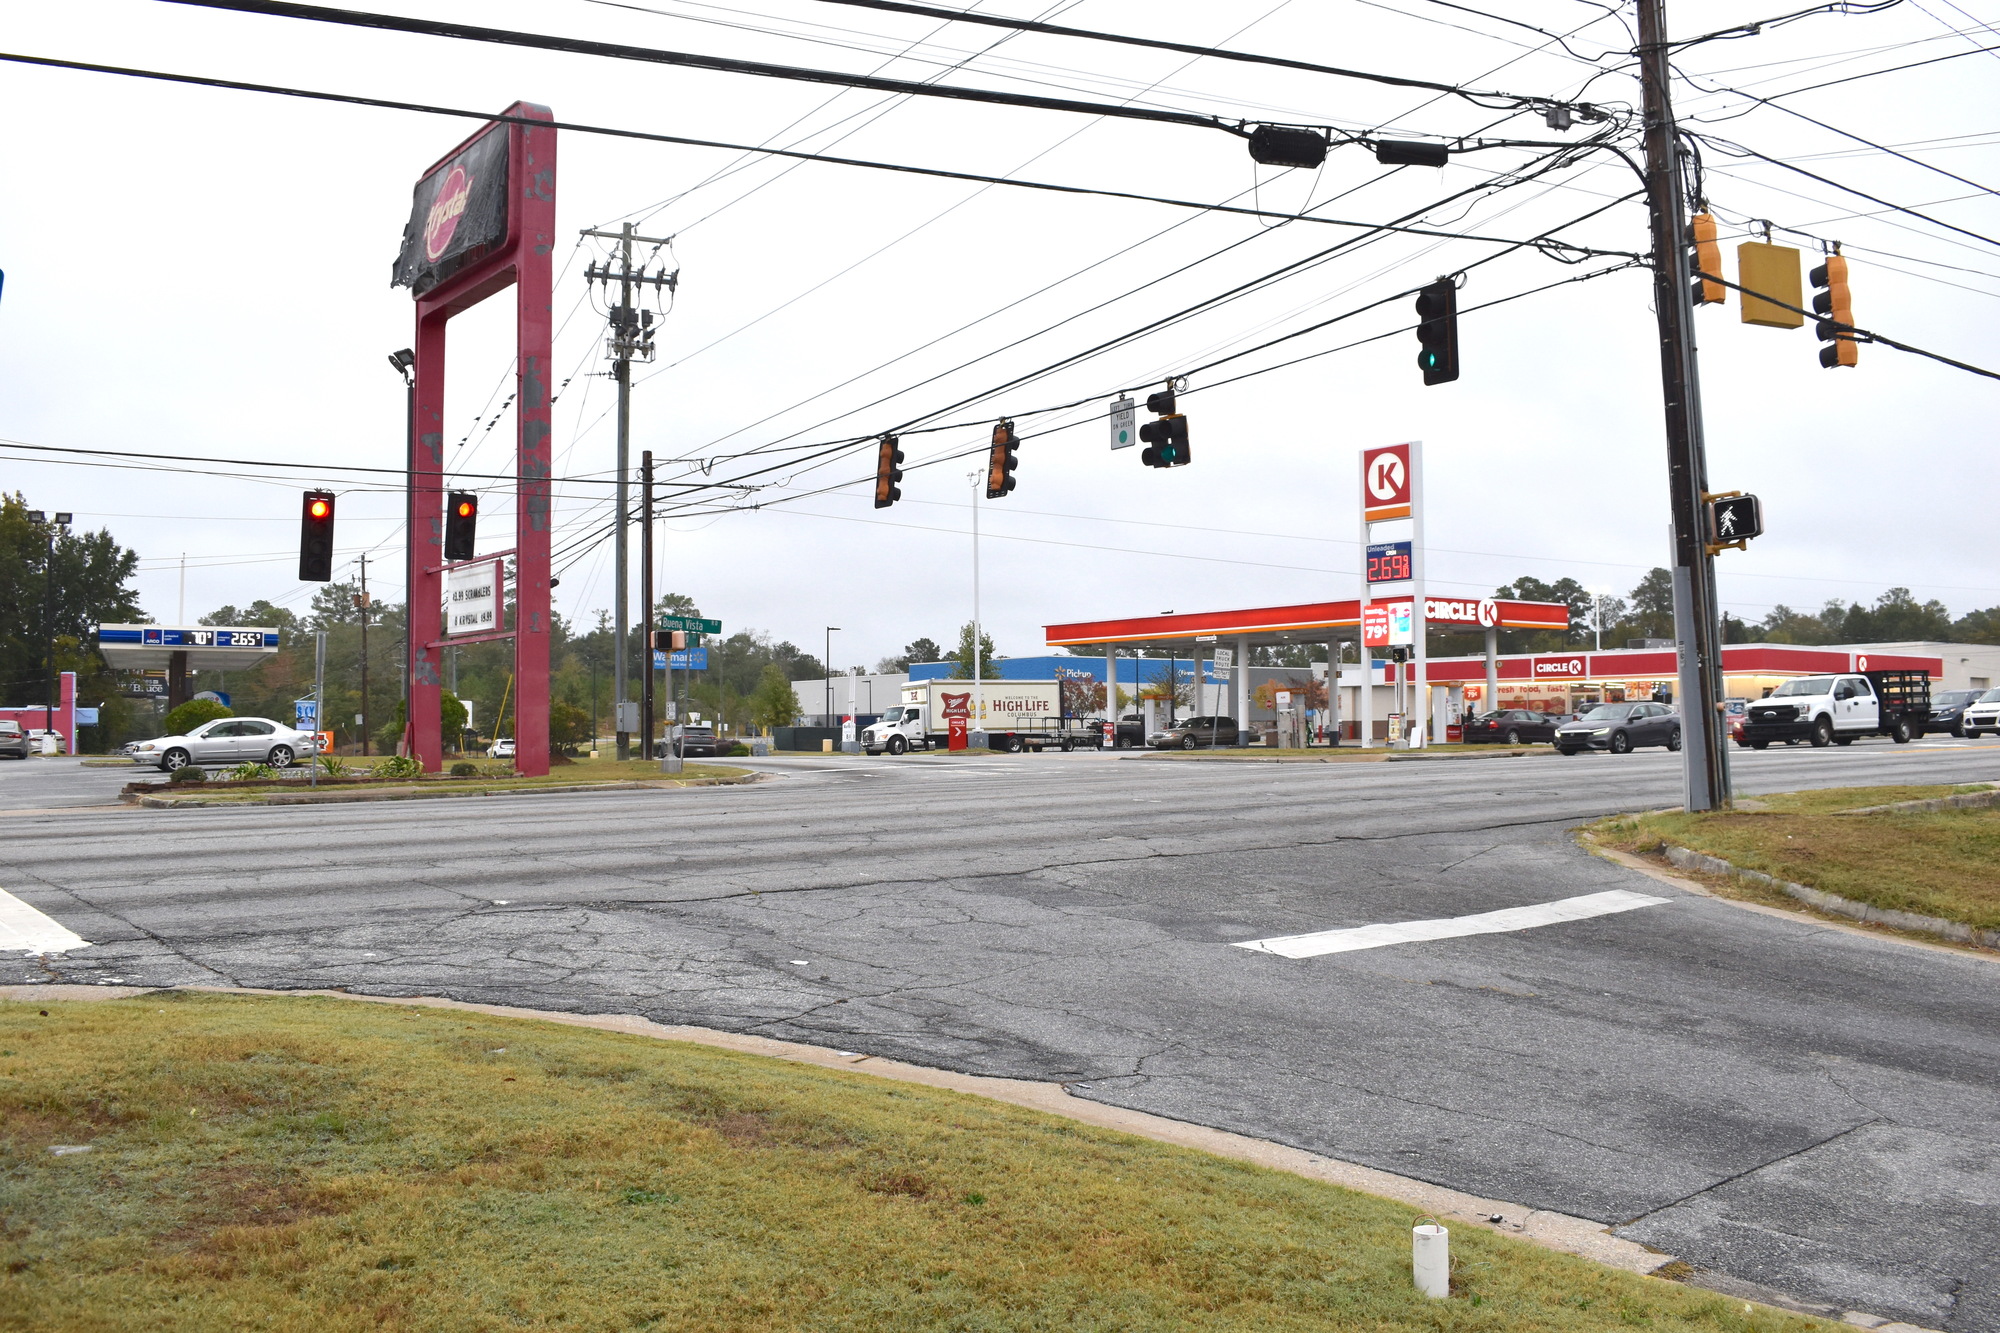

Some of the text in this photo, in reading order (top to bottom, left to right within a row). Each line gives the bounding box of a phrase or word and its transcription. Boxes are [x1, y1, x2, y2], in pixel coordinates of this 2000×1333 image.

[1116, 411, 1129, 420] YIELD
[1120, 421, 1133, 429] GREEN
[1367, 544, 1395, 552] Unleaded
[1425, 600, 1497, 627] CIRCLE K
[662, 617, 683, 629] Buena
[686, 619, 703, 631] Vista
[653, 652, 693, 662] Wamart
[1536, 663, 1568, 673] CIRCLE
[1066, 669, 1092, 678] Pickup
[1519, 686, 1541, 694] food,
[993, 700, 1050, 711] HIGH LIFE
